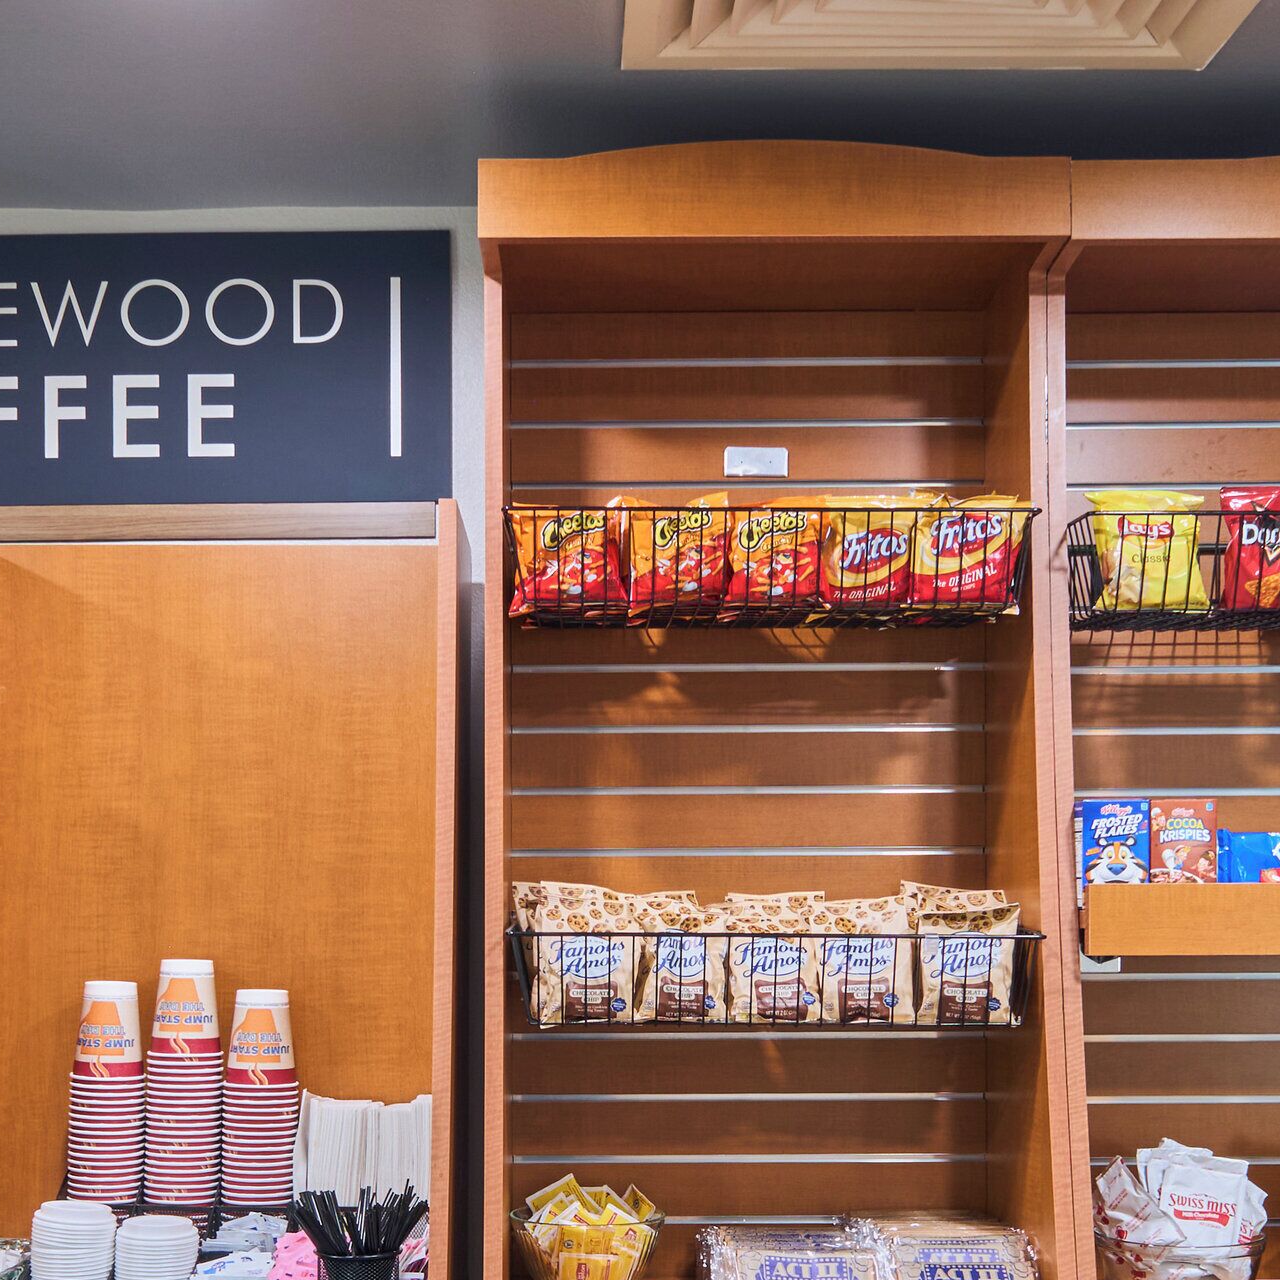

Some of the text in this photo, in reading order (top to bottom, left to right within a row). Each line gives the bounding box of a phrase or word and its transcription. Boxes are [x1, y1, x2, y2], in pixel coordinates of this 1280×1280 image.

[542, 511, 606, 550] Cheetos
[653, 509, 711, 550] Cheetos
[738, 510, 807, 551] Cheetos
[931, 514, 1003, 555] Fritos
[839, 531, 909, 569] Fritos
[1091, 813, 1143, 830] FROSTED
[1166, 818, 1205, 830] COCOA
[1094, 823, 1139, 838] FLAKES
[1160, 829, 1211, 844] KRISPIES
[549, 938, 625, 965] Famous
[734, 939, 808, 966] Famous
[820, 938, 894, 967] Famous
[561, 955, 621, 976] Amos
[181, 1001, 206, 1012] THE
[183, 1014, 214, 1025] JUMP
[101, 1025, 126, 1036] THE
[259, 1032, 283, 1043] THE
[104, 1038, 136, 1049] JUMP
[262, 1045, 291, 1056] JUMP
[1169, 1193, 1204, 1209] SWISS
[771, 1261, 840, 1280] ACT II
[975, 1266, 1000, 1280] II
